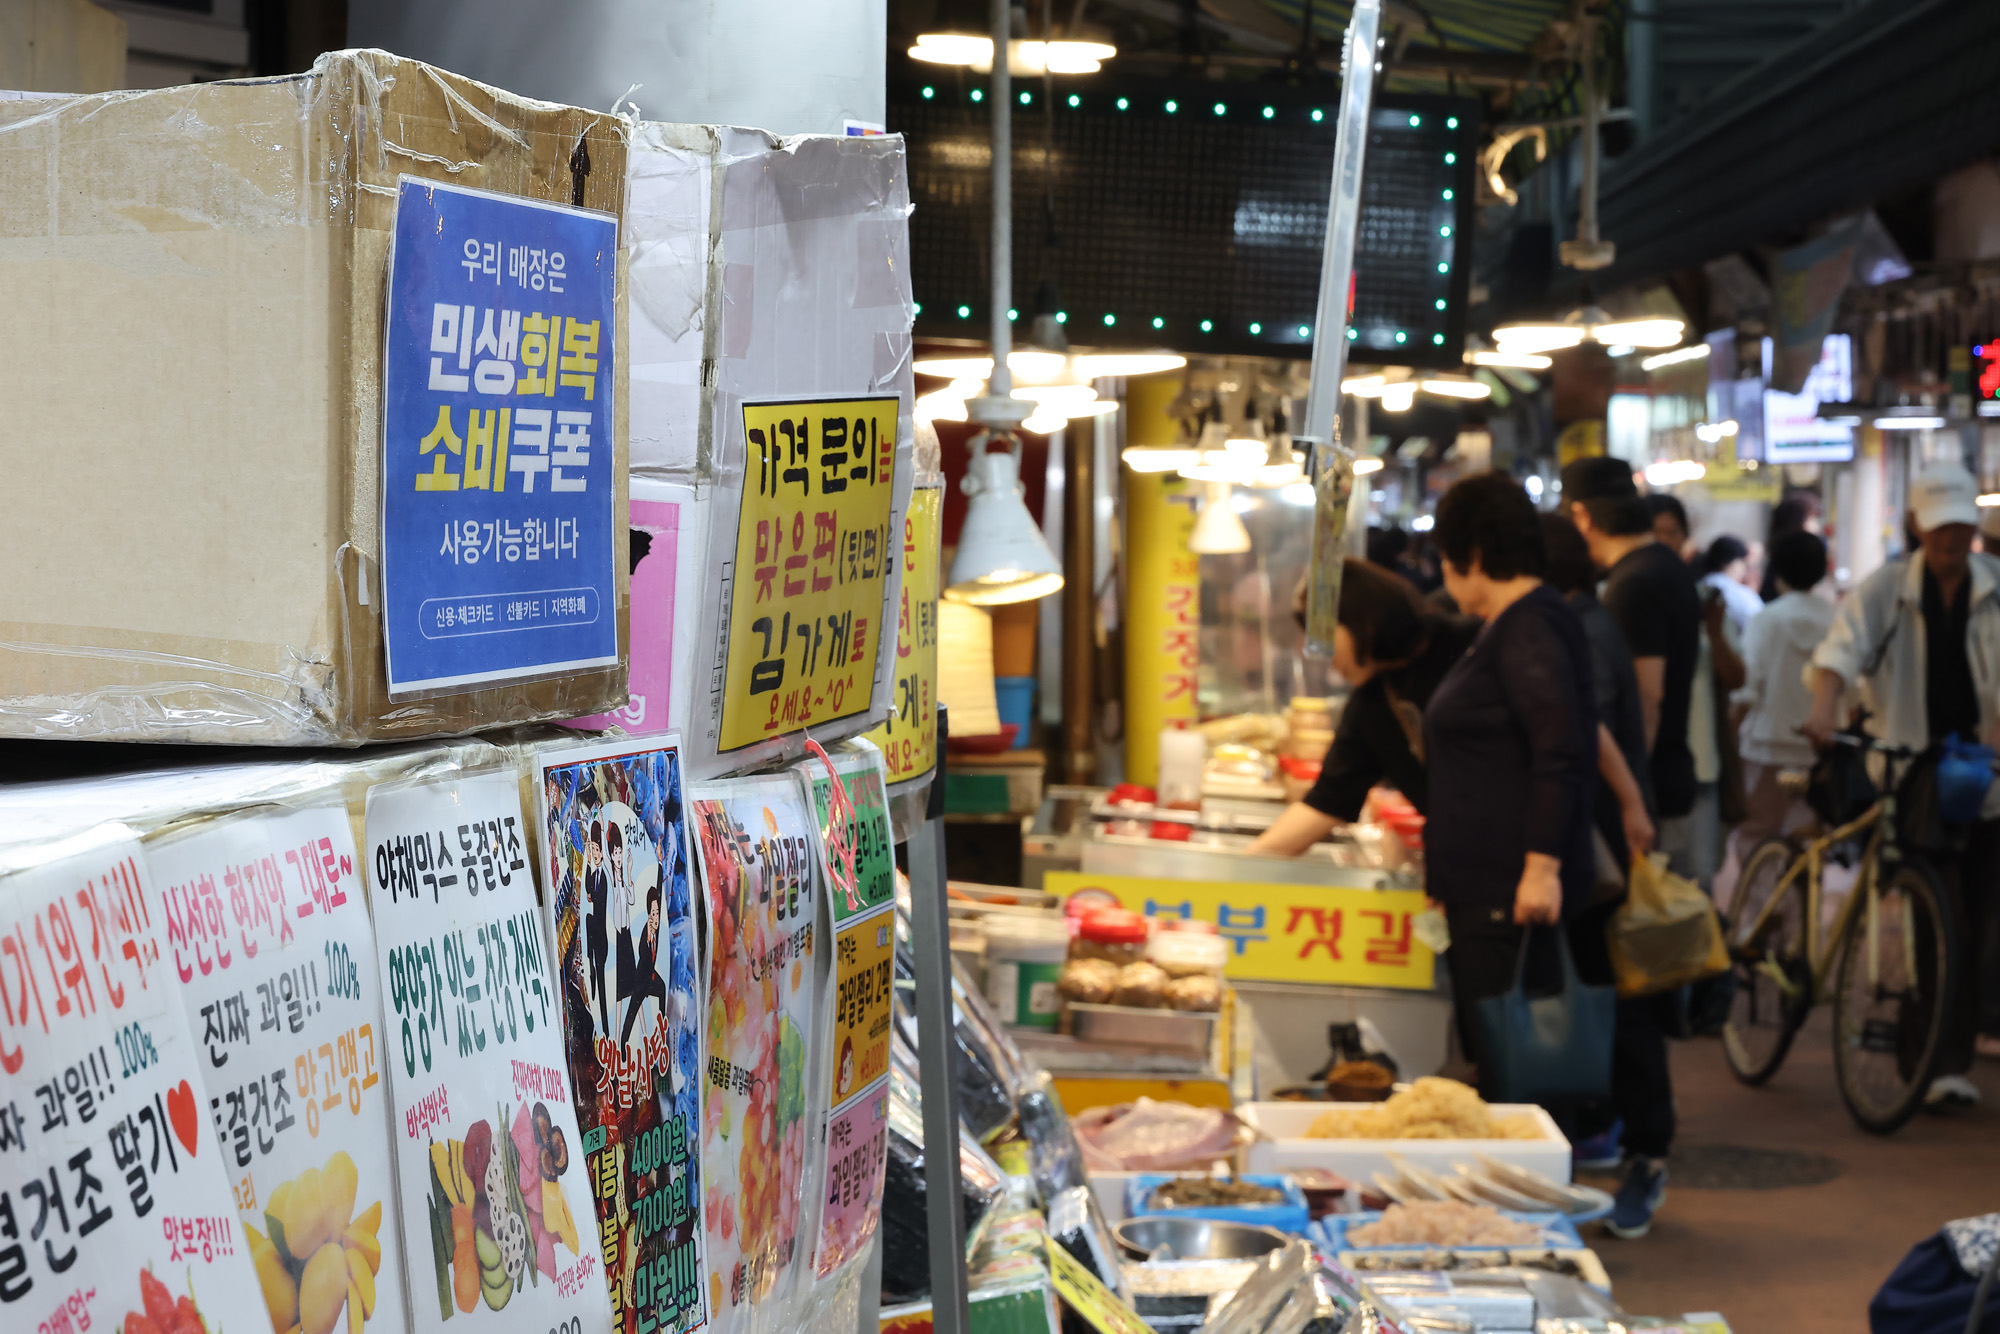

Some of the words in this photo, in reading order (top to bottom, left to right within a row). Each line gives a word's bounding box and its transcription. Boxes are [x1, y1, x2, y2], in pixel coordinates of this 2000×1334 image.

[461, 238, 501, 286] 우리
[509, 246, 566, 294] 매장은
[428, 302, 600, 400] 민생회복
[415, 405, 592, 493] 소비쿠폰
[749, 417, 809, 498] 가격
[821, 416, 893, 495] 문의는
[440, 517, 579, 565] 사용가능합니다
[506, 601, 540, 621] 선불카드
[551, 595, 586, 616] 지역화폐
[376, 829, 458, 904] 야채믹스
[459, 816, 525, 897] 동결건조
[625, 817, 647, 851] 맛있어
[755, 834, 812, 921] 과일젤리
[162, 872, 231, 983] 신선한
[225, 853, 294, 959] 현지맛
[285, 837, 352, 919] 그대로~
[36, 896, 98, 1019] 1위
[389, 932, 448, 1078] 영양가
[444, 928, 486, 1058] 있는
[478, 918, 517, 1044] 건강
[507, 908, 549, 1033] 간식!
[837, 966, 874, 1029] 과일젤리
[876, 957, 890, 1007] 2팩
[200, 990, 251, 1068] 진짜
[257, 960, 320, 1034] 과일!!
[324, 939, 360, 1001] 100%
[35, 1045, 115, 1133] 과일!!
[115, 1020, 159, 1080] 100%
[211, 1067, 296, 1168] 결건조
[295, 1023, 379, 1138] 망고맹고
[511, 1059, 543, 1101] 진짜야채
[543, 1066, 565, 1103] 100%
[597, 1012, 670, 1108] 옛날사탕
[109, 1092, 178, 1219] 딸기
[406, 1084, 448, 1140] 바삭바삭
[588, 1131, 601, 1149] 가격
[592, 1146, 619, 1200] 1봉
[631, 1112, 687, 1179] 4000원
[829, 1139, 870, 1208] 과일젤리
[163, 1215, 234, 1264] 맛보장!!!
[599, 1212, 620, 1267] 봉
[631, 1175, 688, 1248] 7000원
[557, 1265, 577, 1298] 자꾸만
[635, 1238, 699, 1334] 만원!!!
